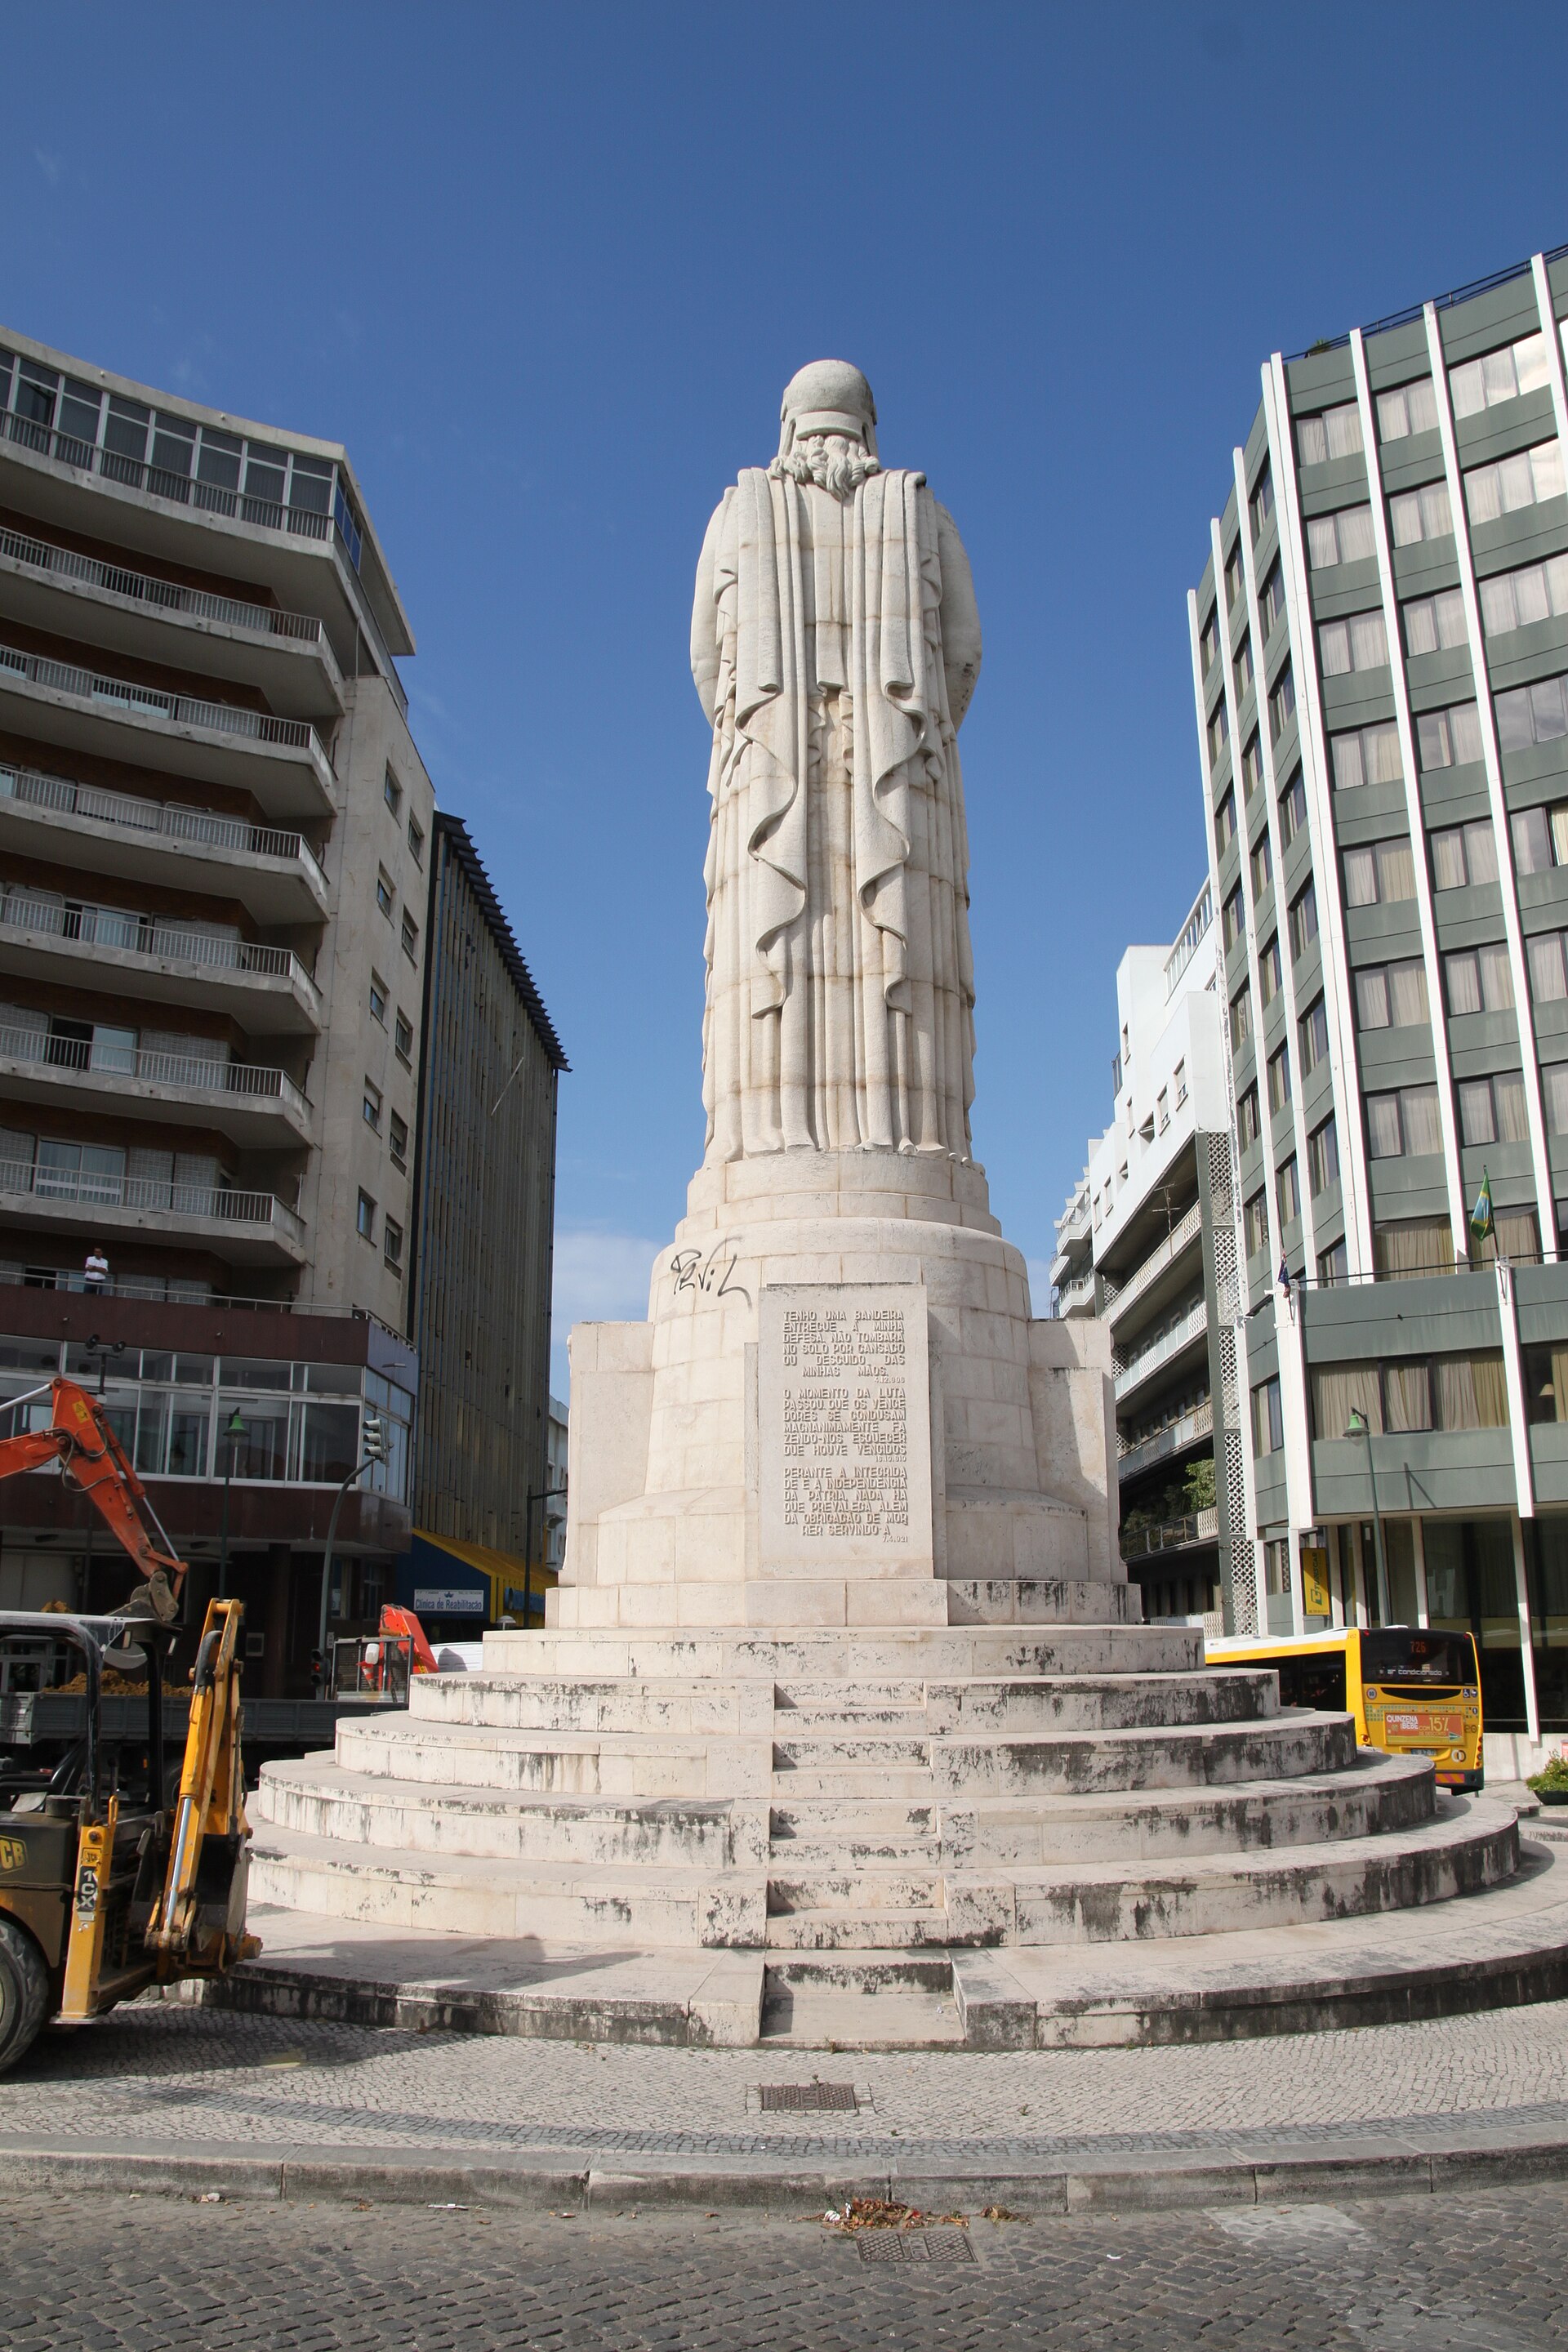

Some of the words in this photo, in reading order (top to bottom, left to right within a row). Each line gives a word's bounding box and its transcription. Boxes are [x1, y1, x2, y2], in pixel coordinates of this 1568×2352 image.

[784, 1312, 817, 1321] TENHO
[825, 1311, 846, 1321] UMA
[855, 1311, 904, 1321] BANDEIRA
[783, 1322, 836, 1332] ENTREGUE
[874, 1321, 904, 1332] MINHA
[831, 1331, 851, 1343] NÃO
[783, 1345, 797, 1354] NO
[803, 1345, 829, 1354] SOLO
[833, 1345, 853, 1354] POR
[784, 1356, 797, 1365] OU
[817, 1356, 866, 1365] DESCUIDO
[884, 1356, 905, 1365] DAS
[803, 1366, 840, 1377] MINHAS
[784, 1389, 791, 1399] O
[799, 1388, 849, 1399] MOMENTO
[857, 1388, 871, 1398] DA
[879, 1388, 906, 1398] LUTA
[829, 1400, 849, 1410] QUE
[854, 1400, 867, 1410] OS
[828, 1412, 841, 1421] SE
[851, 1411, 906, 1421] CONDUSAM
[784, 1423, 879, 1433] MAGNANIMAMENTE
[784, 1434, 844, 1445] ZENDO-NOS
[853, 1434, 906, 1444] ESQUECER
[784, 1446, 804, 1456] QUE
[814, 1446, 848, 1456] HOUVE
[858, 1446, 906, 1455] VENCIDOS
[785, 1468, 832, 1478] PERANTE
[840, 1468, 847, 1478] A
[784, 1480, 798, 1490] DE
[803, 1480, 810, 1489] E
[814, 1479, 822, 1490] A
[784, 1491, 798, 1501] DA
[856, 1490, 883, 1501] NADA
[784, 1503, 805, 1512] QUE
[784, 1514, 798, 1525] DA
[866, 1513, 880, 1524] DE
[803, 1526, 823, 1536] RER
[437, 1598, 443, 1609] de
[1410, 1641, 1426, 1653] 726
[1386, 1715, 1419, 1723] QUINZENA
[0, 1840, 24, 1869] CB
